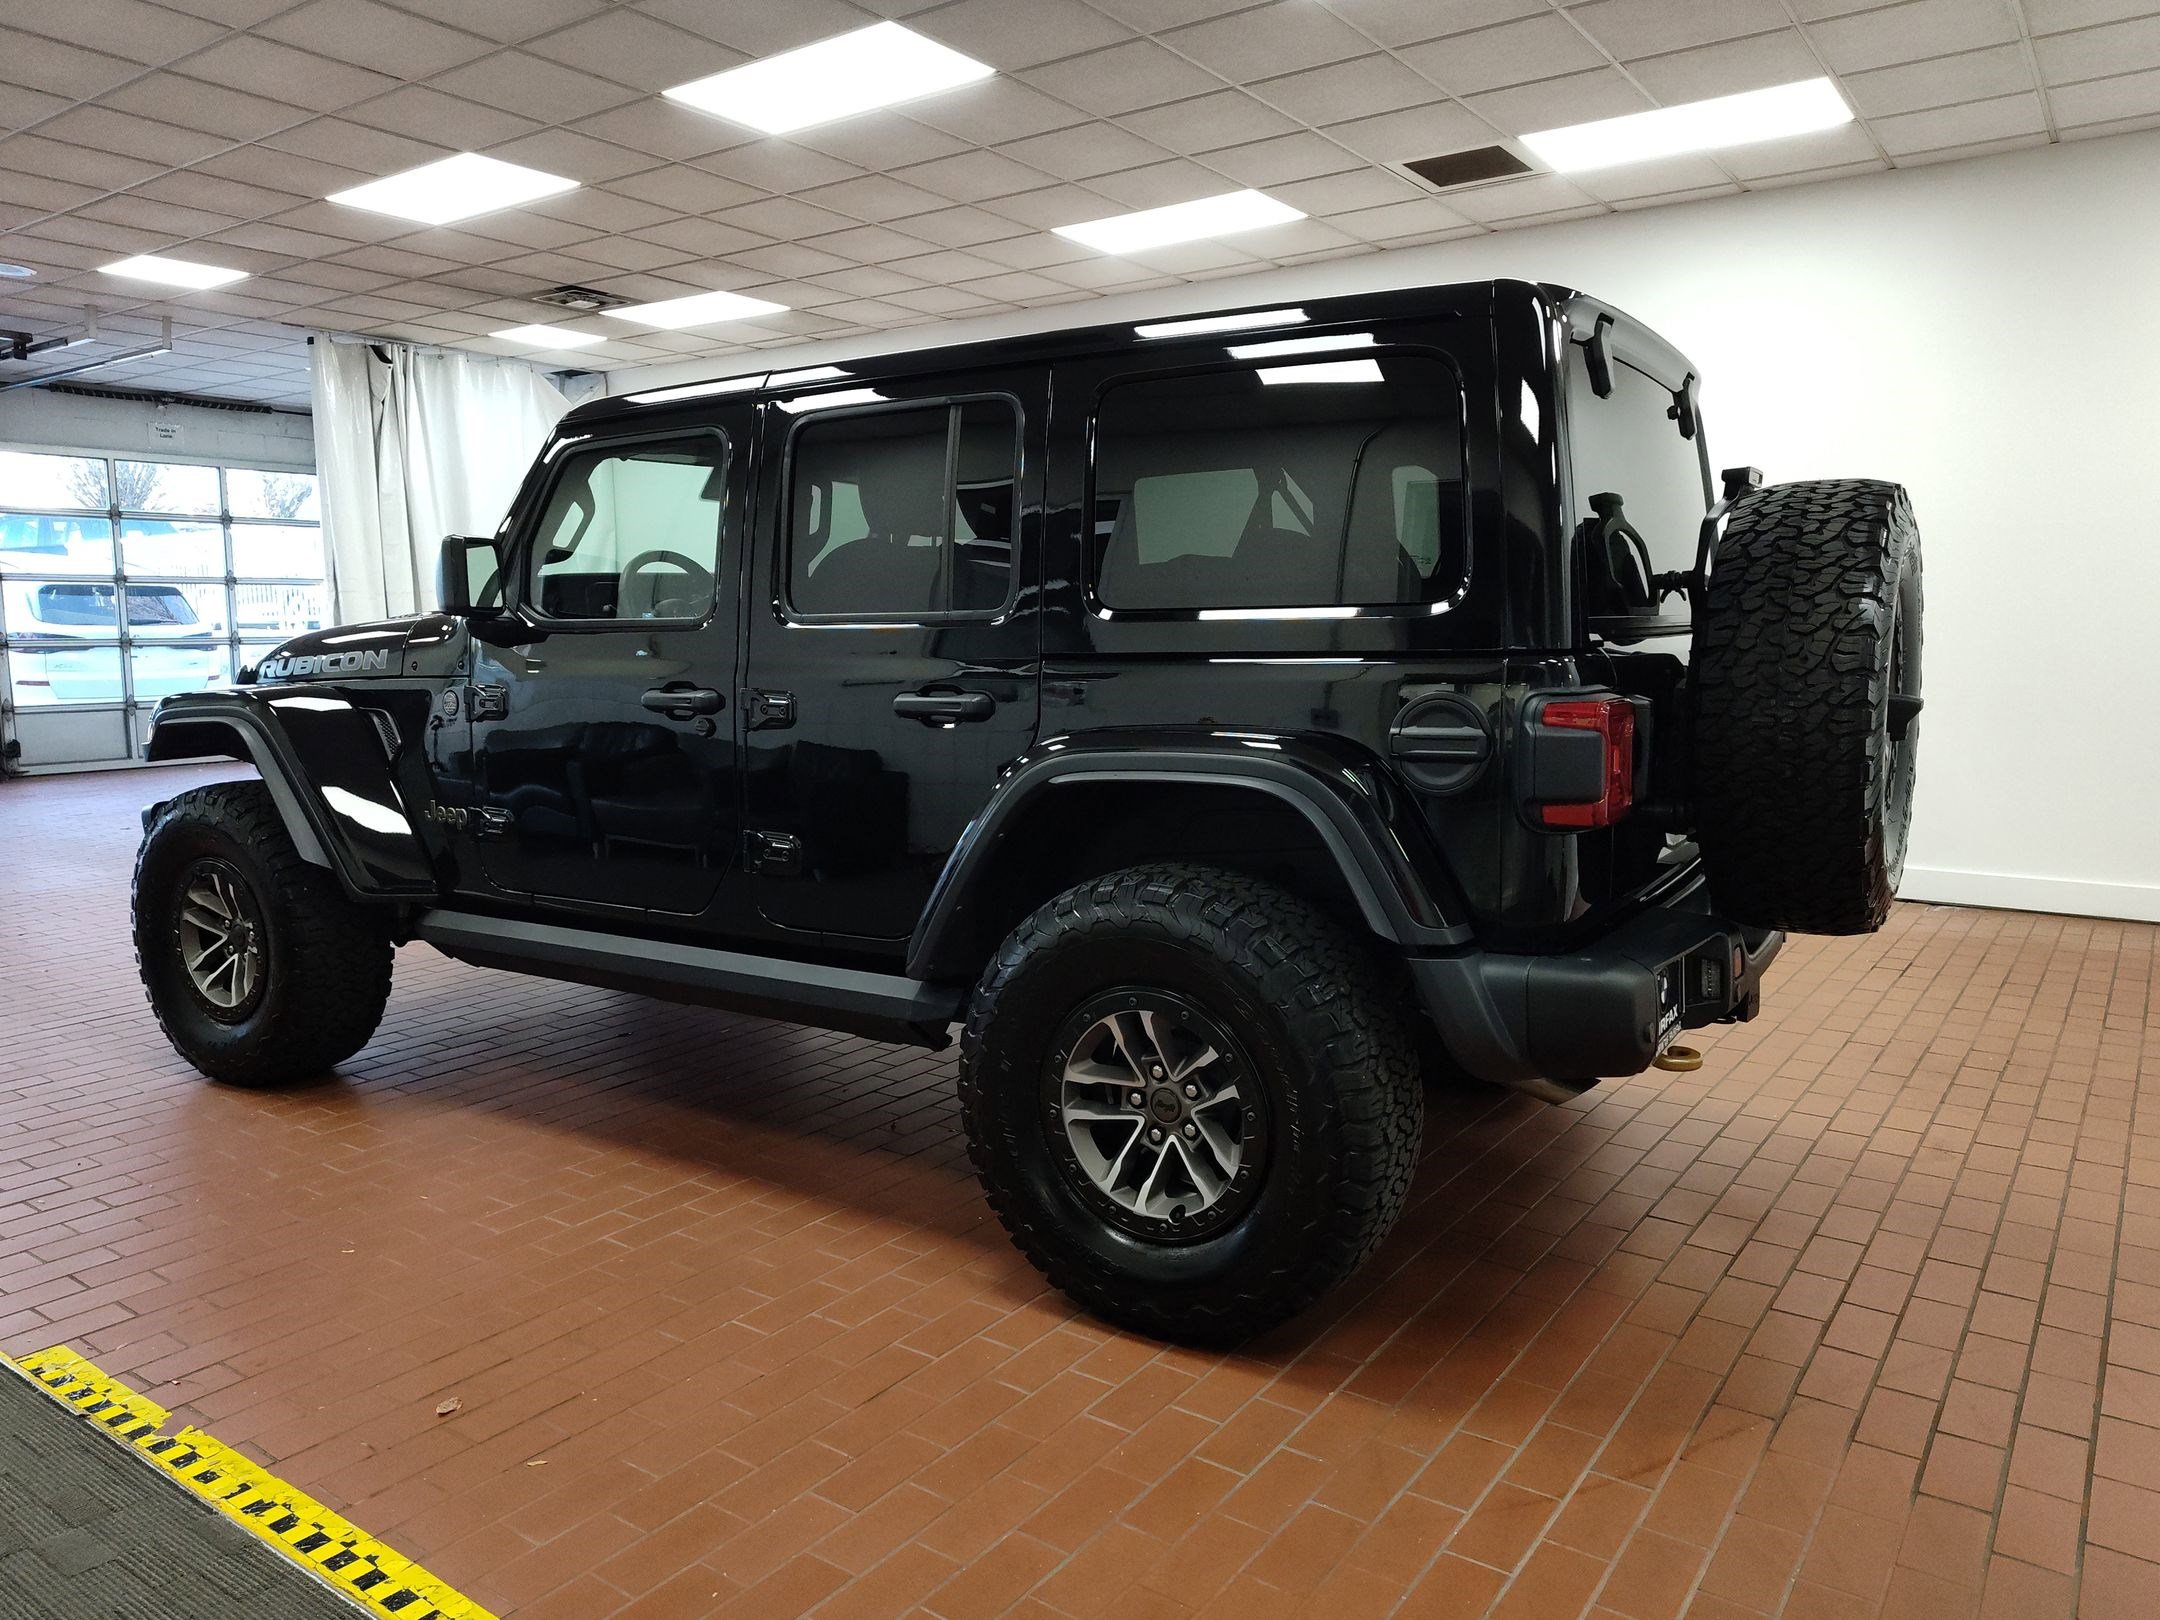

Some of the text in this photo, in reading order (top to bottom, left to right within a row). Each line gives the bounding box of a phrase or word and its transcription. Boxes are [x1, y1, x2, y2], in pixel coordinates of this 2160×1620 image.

[256, 648, 389, 684] RUBICON
[424, 799, 468, 830] Jeep
[1658, 1003, 1679, 1036] IRFAX
